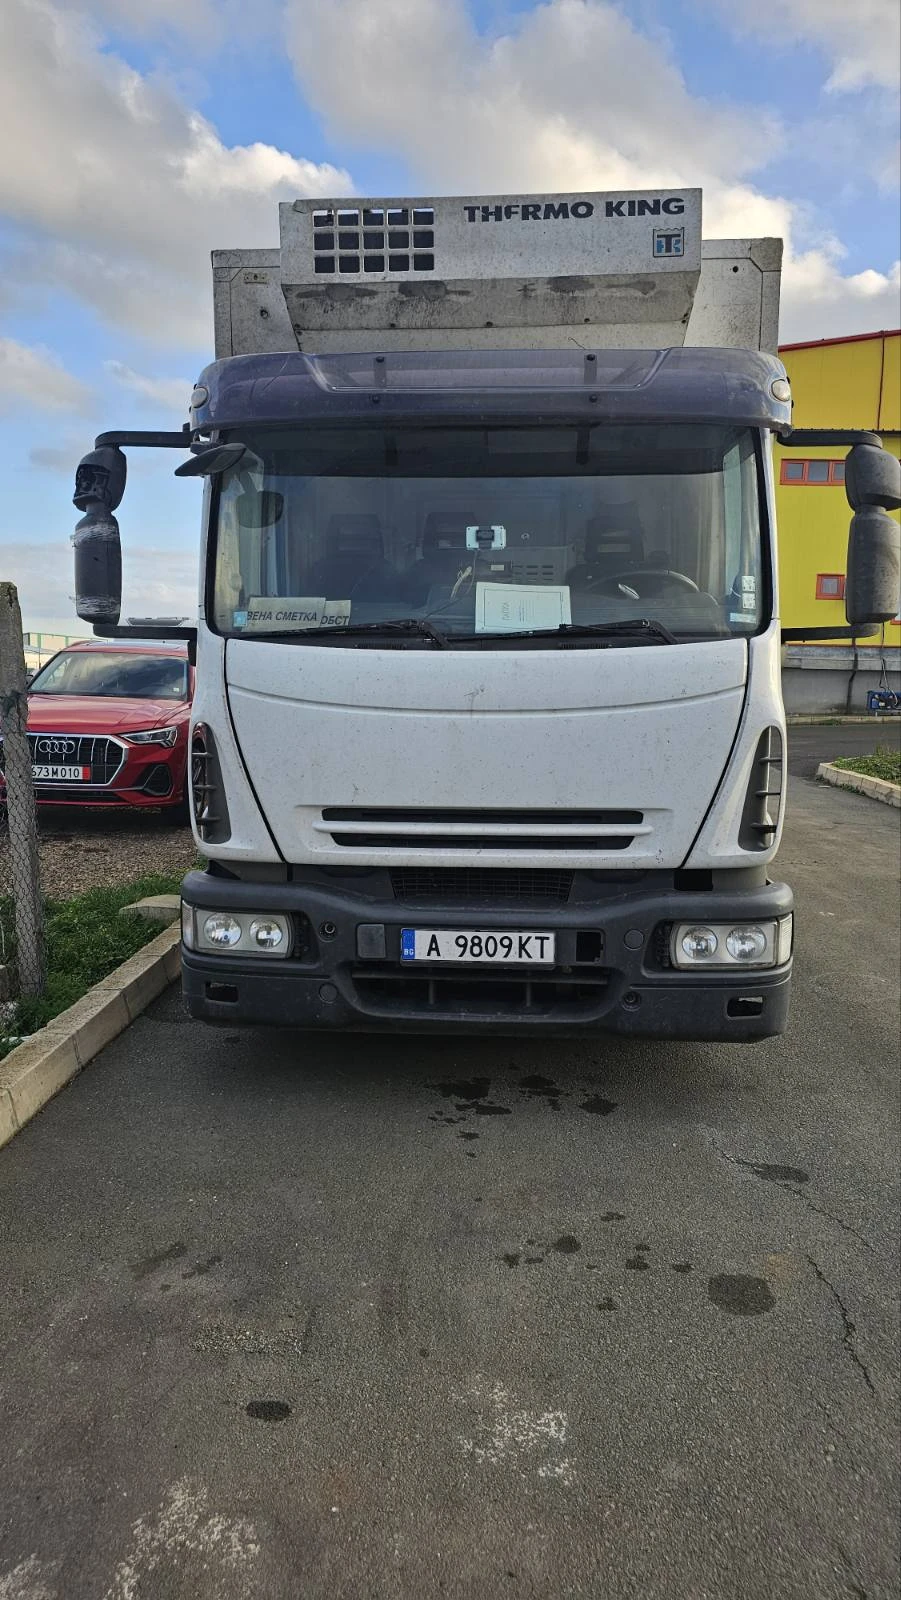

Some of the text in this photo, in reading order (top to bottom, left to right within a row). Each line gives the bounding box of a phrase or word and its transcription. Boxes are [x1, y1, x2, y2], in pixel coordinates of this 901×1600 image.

[605, 197, 685, 217] KING
[275, 611, 317, 621] СМЕТКА
[426, 934, 441, 957] A
